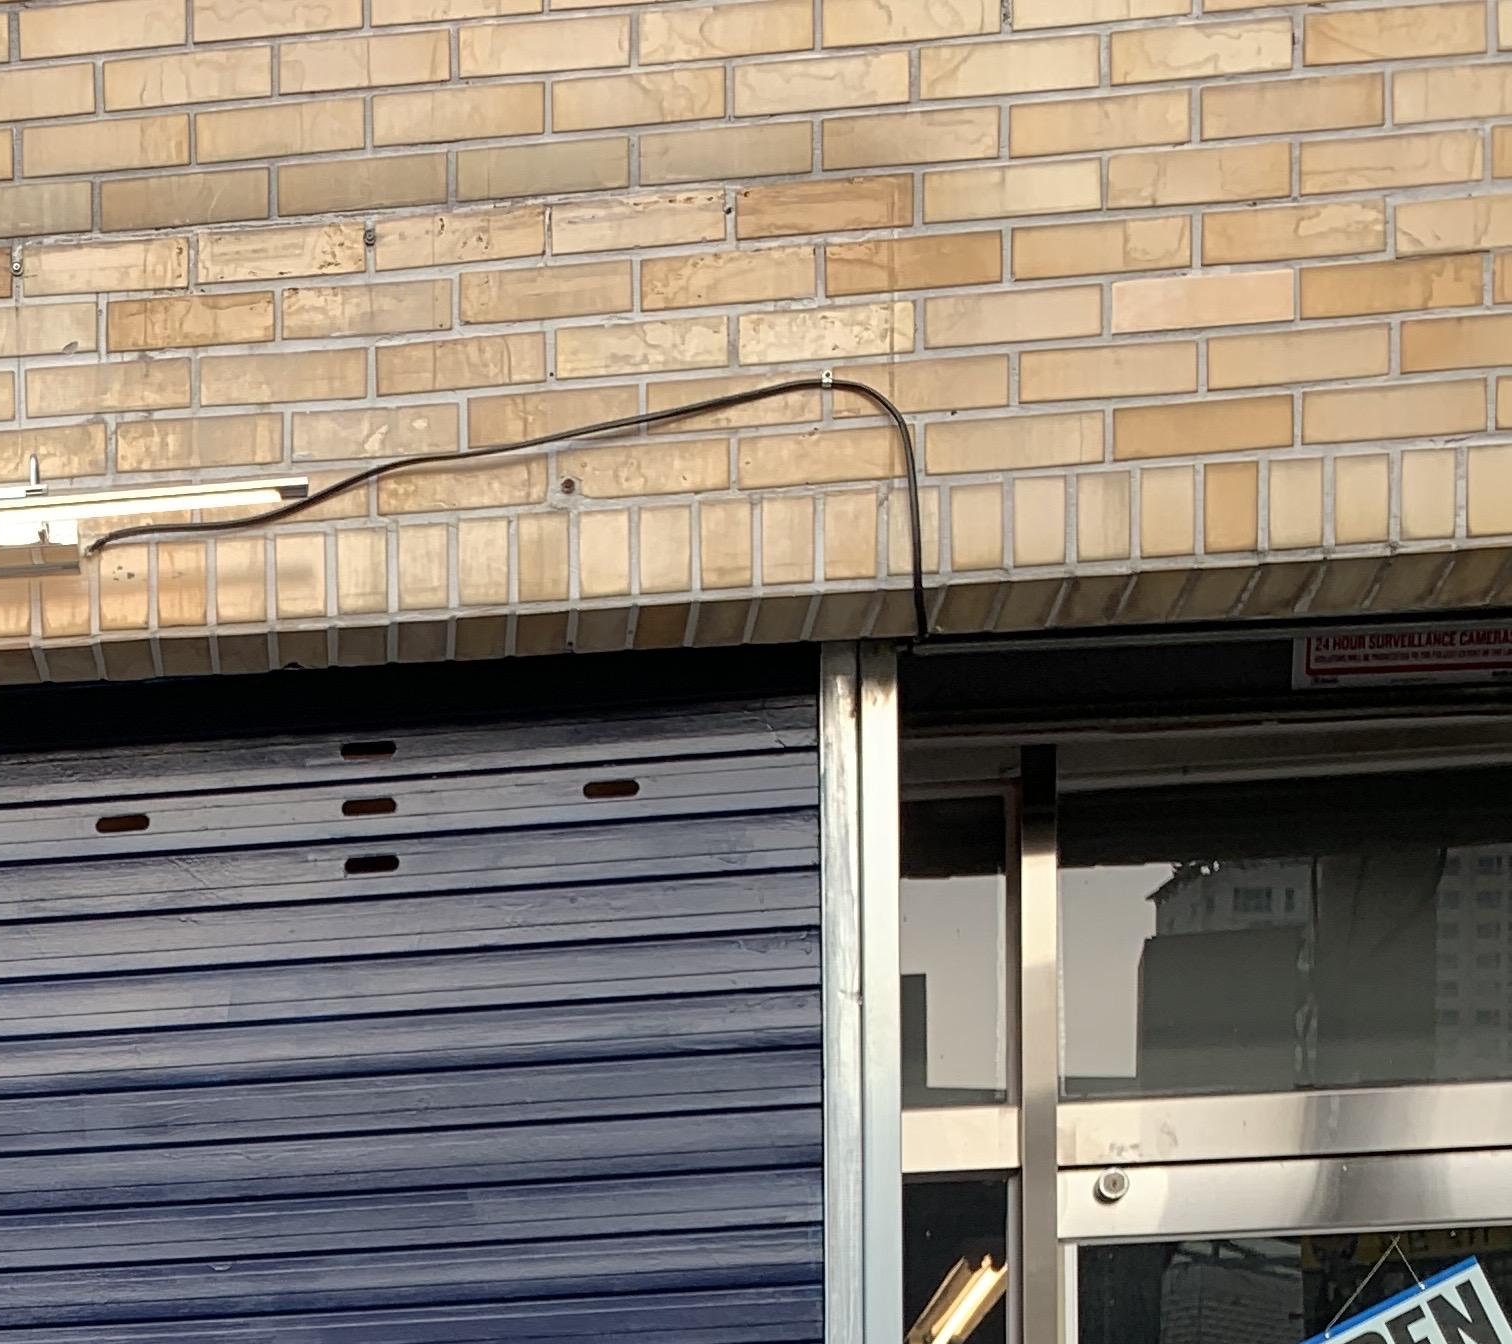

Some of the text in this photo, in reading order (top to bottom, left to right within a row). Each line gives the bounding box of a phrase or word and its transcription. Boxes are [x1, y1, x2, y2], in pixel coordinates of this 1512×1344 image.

[1315, 627, 1512, 651] 24 HOUR SURVEILLANCE CAMERA
